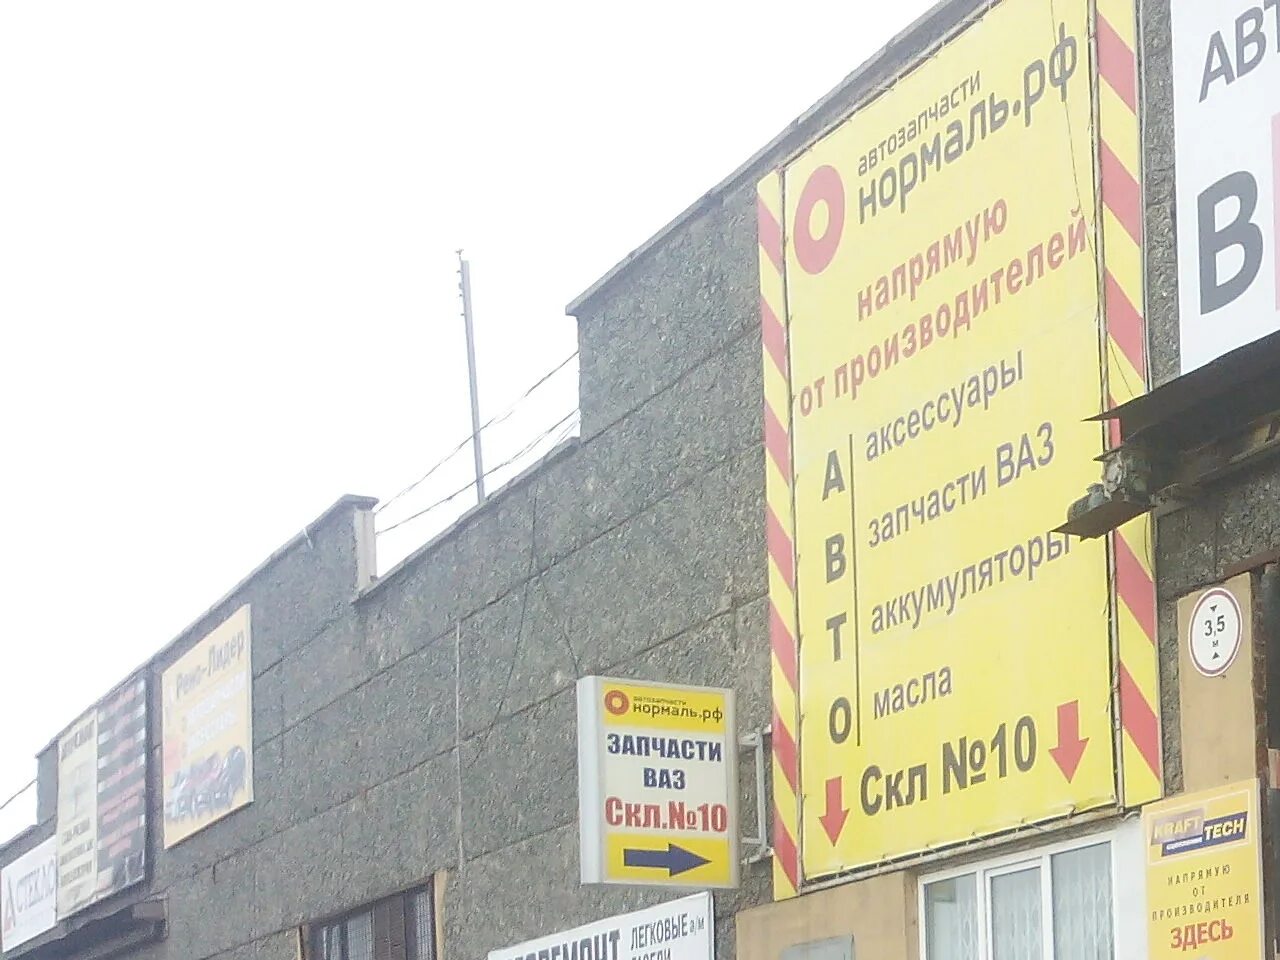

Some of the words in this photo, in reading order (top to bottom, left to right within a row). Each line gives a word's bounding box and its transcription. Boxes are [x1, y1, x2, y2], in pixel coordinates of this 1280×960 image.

[858, 22, 1077, 224] нормаль.рф
[858, 70, 981, 177] автозапчасти
[857, 198, 1008, 322] напрямую
[800, 375, 825, 417] от
[834, 205, 1087, 399] производителей
[866, 351, 1023, 462] аксессуары
[868, 466, 986, 548] запчасти
[998, 421, 1054, 487] ВАЗ
[871, 527, 1071, 635] аккумуляторы
[1204, 615, 1225, 637] 3,5
[633, 702, 723, 723] нормаль.рф
[873, 666, 952, 721] масла
[607, 733, 722, 762] ЗАПЧАСТИ
[860, 761, 928, 816] Скл
[942, 715, 1037, 794] №10
[643, 768, 685, 789] ВАЗ
[1153, 815, 1201, 839] KRAFT
[1203, 818, 1246, 842] TECH
[1167, 865, 1231, 886] НАПРЯМУЮ
[1192, 885, 1206, 897] ОТ
[1152, 894, 1250, 922] ПРОИЗВОДИТЕЛЯ
[630, 913, 688, 951] ЛЕГКОВЫЕ
[1170, 918, 1233, 951] ЗДЕСЬ
